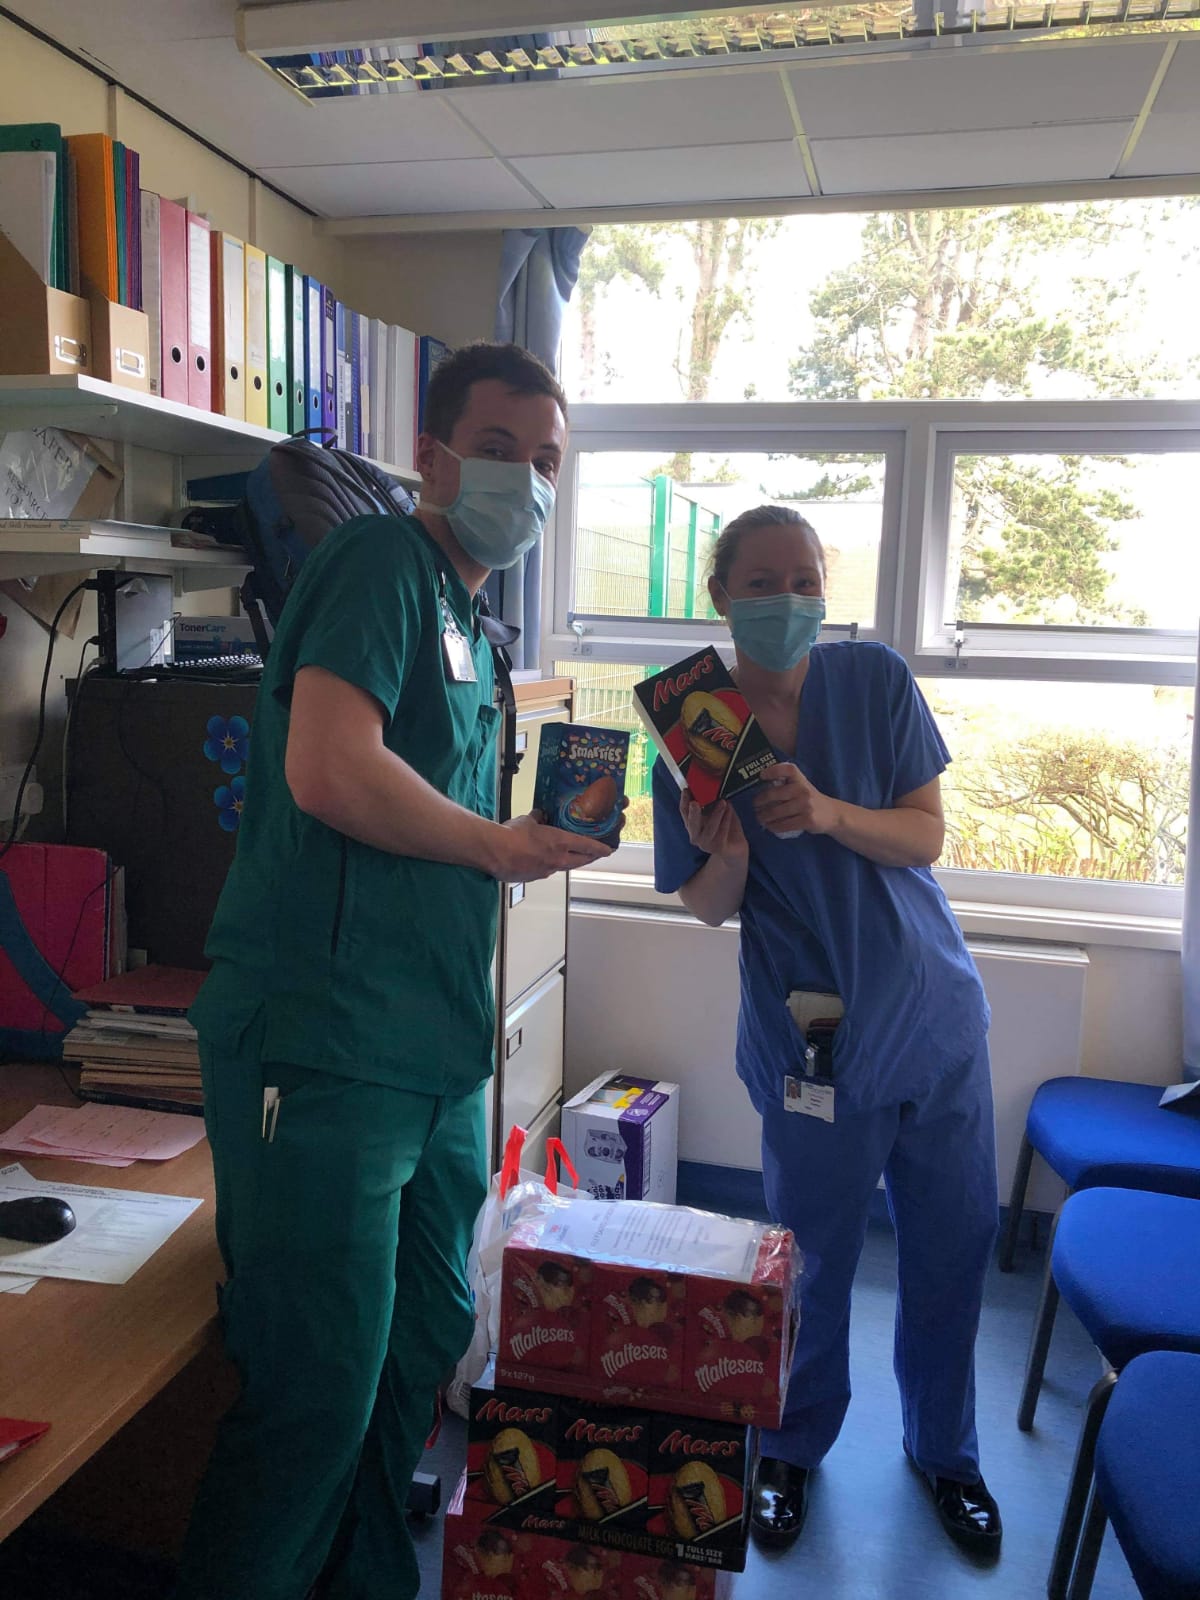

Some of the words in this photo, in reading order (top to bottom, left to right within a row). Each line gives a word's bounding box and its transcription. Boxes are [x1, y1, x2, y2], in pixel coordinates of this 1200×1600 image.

[32, 427, 73, 475] AFER
[179, 623, 227, 633] TonerCare
[652, 654, 715, 712] Mars
[759, 752, 775, 763] SIZE
[509, 1325, 575, 1360] Maltesers
[600, 1342, 669, 1378] Maltesers
[694, 1354, 765, 1393] Maltesers
[475, 1397, 553, 1424] Mars
[565, 1417, 644, 1443] Mars
[658, 1429, 741, 1457] Mars
[520, 1514, 566, 1530] Mars
[601, 1530, 655, 1552] CHOCOLATE
[655, 1539, 674, 1555] EGG
[675, 1543, 685, 1558] 1
[685, 1545, 704, 1555] FULL
[705, 1548, 723, 1558] SIZE
